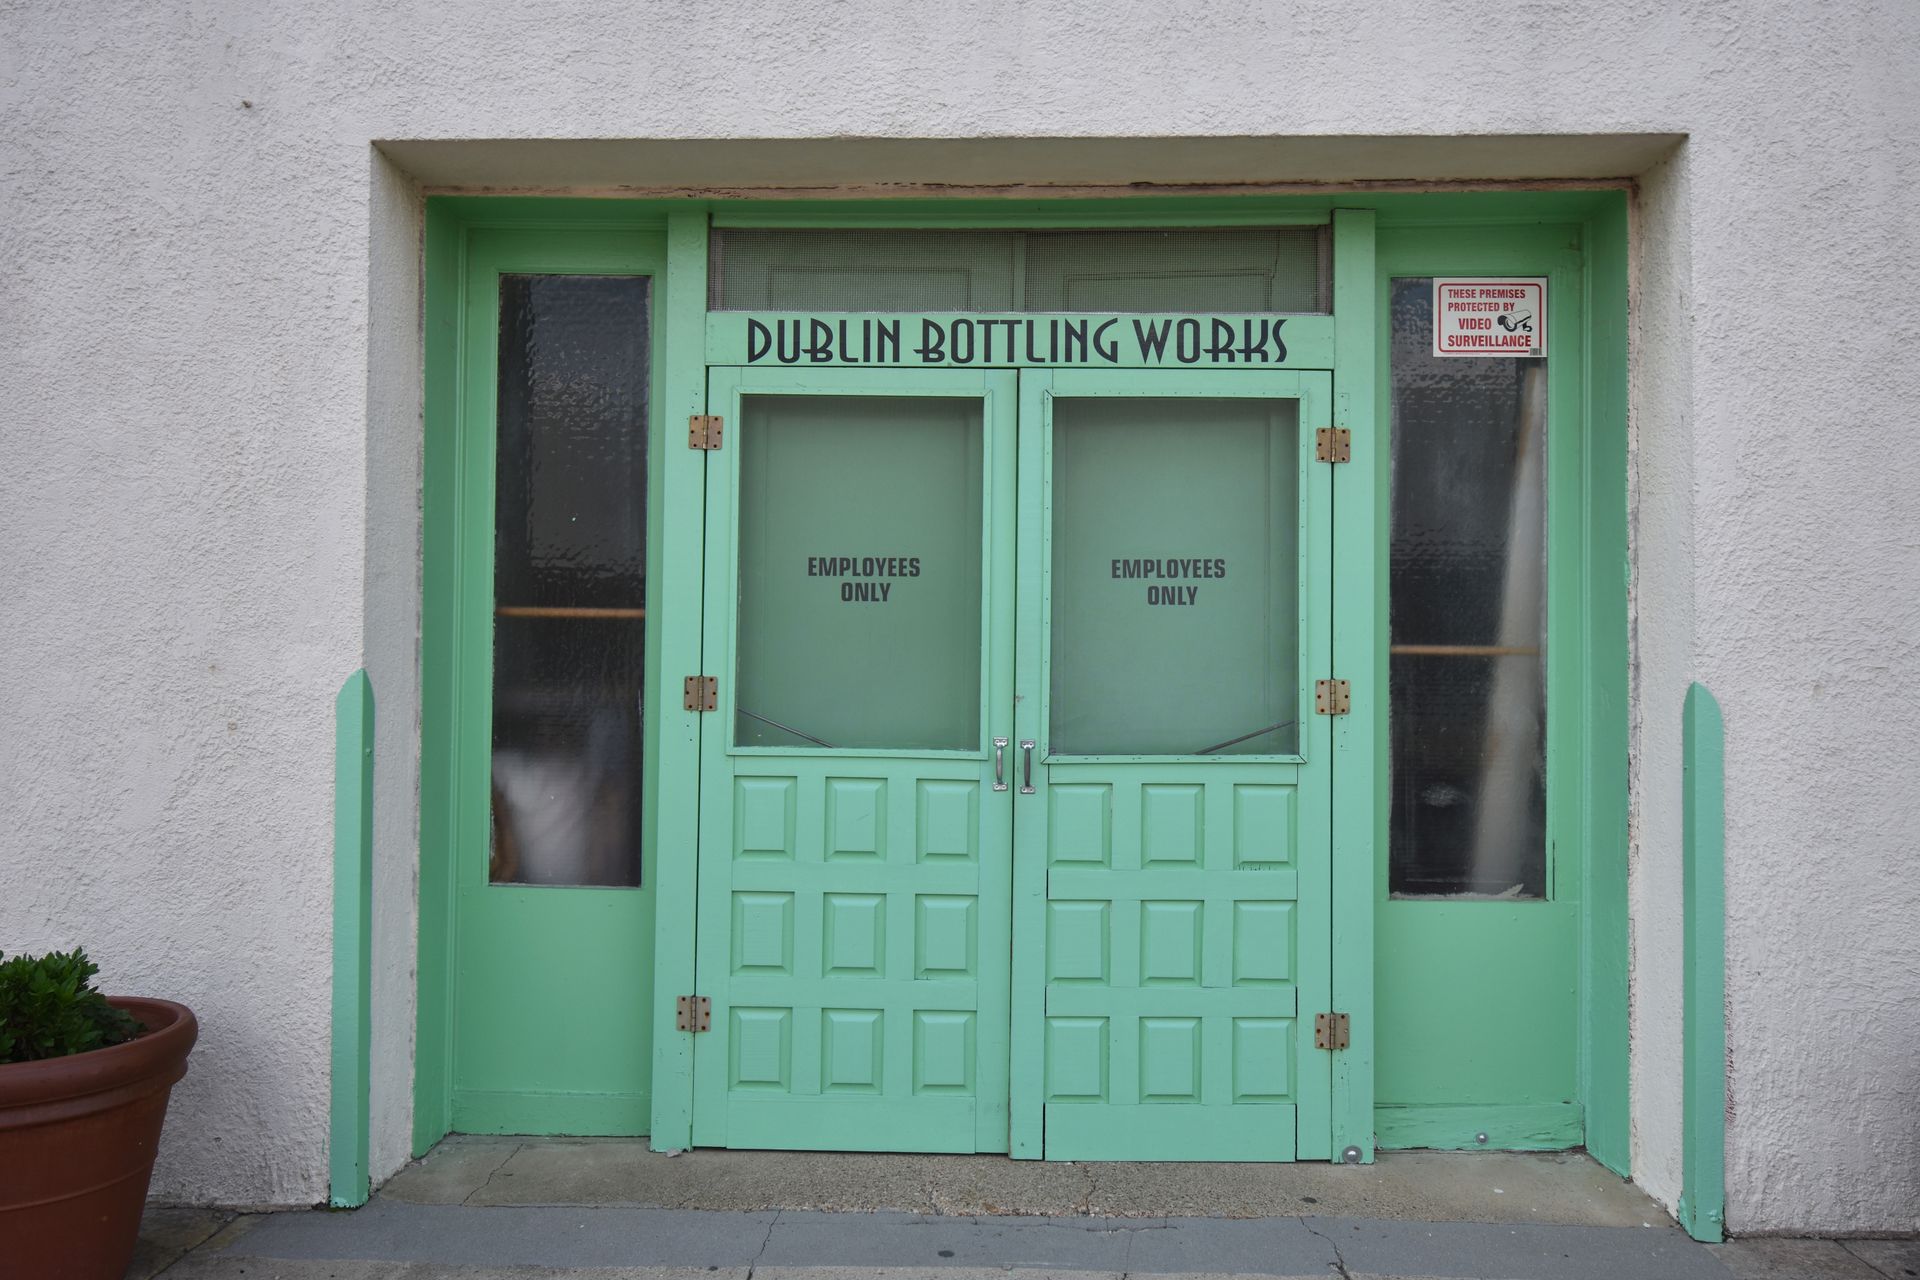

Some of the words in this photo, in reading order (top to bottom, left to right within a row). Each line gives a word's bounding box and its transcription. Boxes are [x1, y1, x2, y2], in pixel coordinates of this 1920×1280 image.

[1448, 289, 1476, 299] THESE
[1479, 289, 1526, 299] PREMISES
[1448, 302, 1500, 312] PROTECTED
[1503, 302, 1515, 312] BY
[1458, 318, 1492, 330] VIDEO
[747, 318, 901, 364] DUBLIN
[913, 317, 1119, 364] BOTTLING
[1131, 318, 1288, 365] WORKS
[1447, 335, 1532, 347] SURVEILLANCE
[807, 557, 921, 578] EMPLOYEES
[1111, 558, 1226, 579] EMPLOYEES
[841, 582, 891, 602] ONLY
[1147, 585, 1198, 606] ONLY
